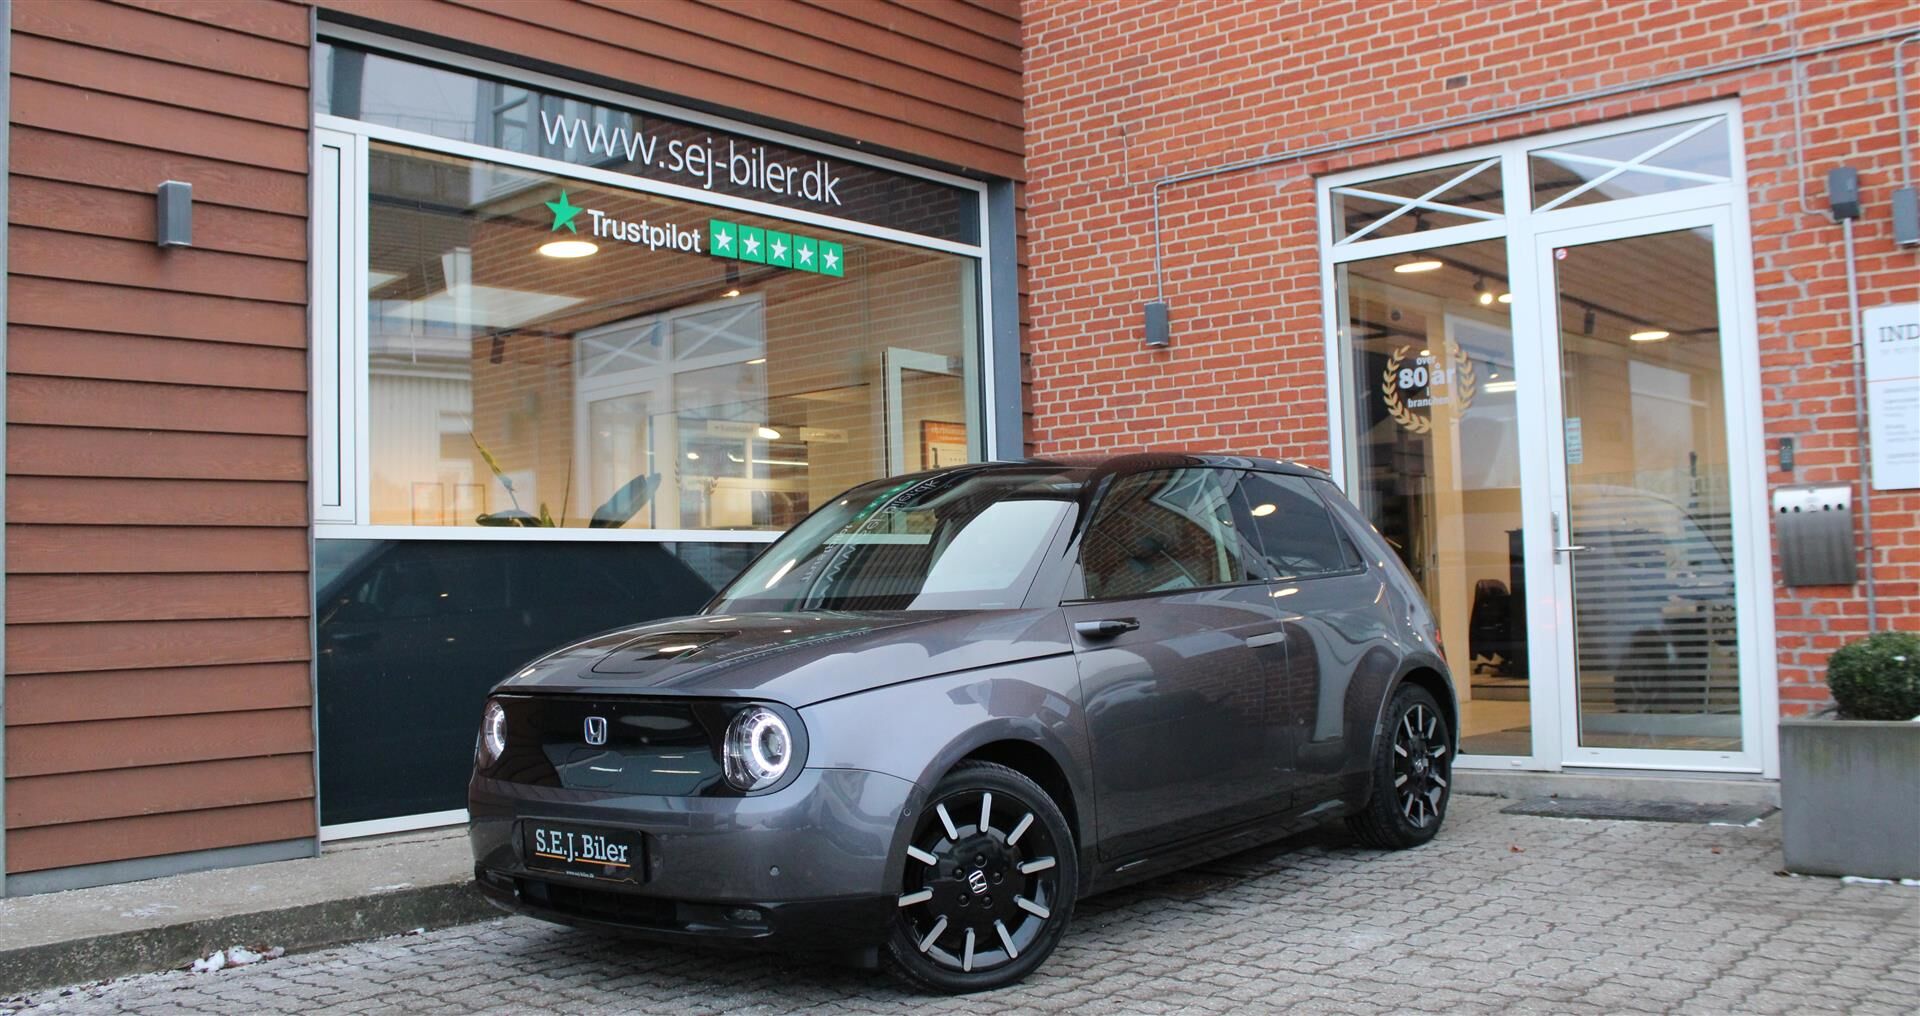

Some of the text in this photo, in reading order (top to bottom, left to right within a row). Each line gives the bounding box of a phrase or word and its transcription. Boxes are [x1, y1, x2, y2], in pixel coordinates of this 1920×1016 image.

[541, 111, 842, 205] www.sej-biler.dk
[587, 209, 701, 252] Trustpilot
[1399, 363, 1455, 389] 80 år
[1416, 356, 1436, 365] over
[535, 828, 628, 862] S.E.J. Biler
